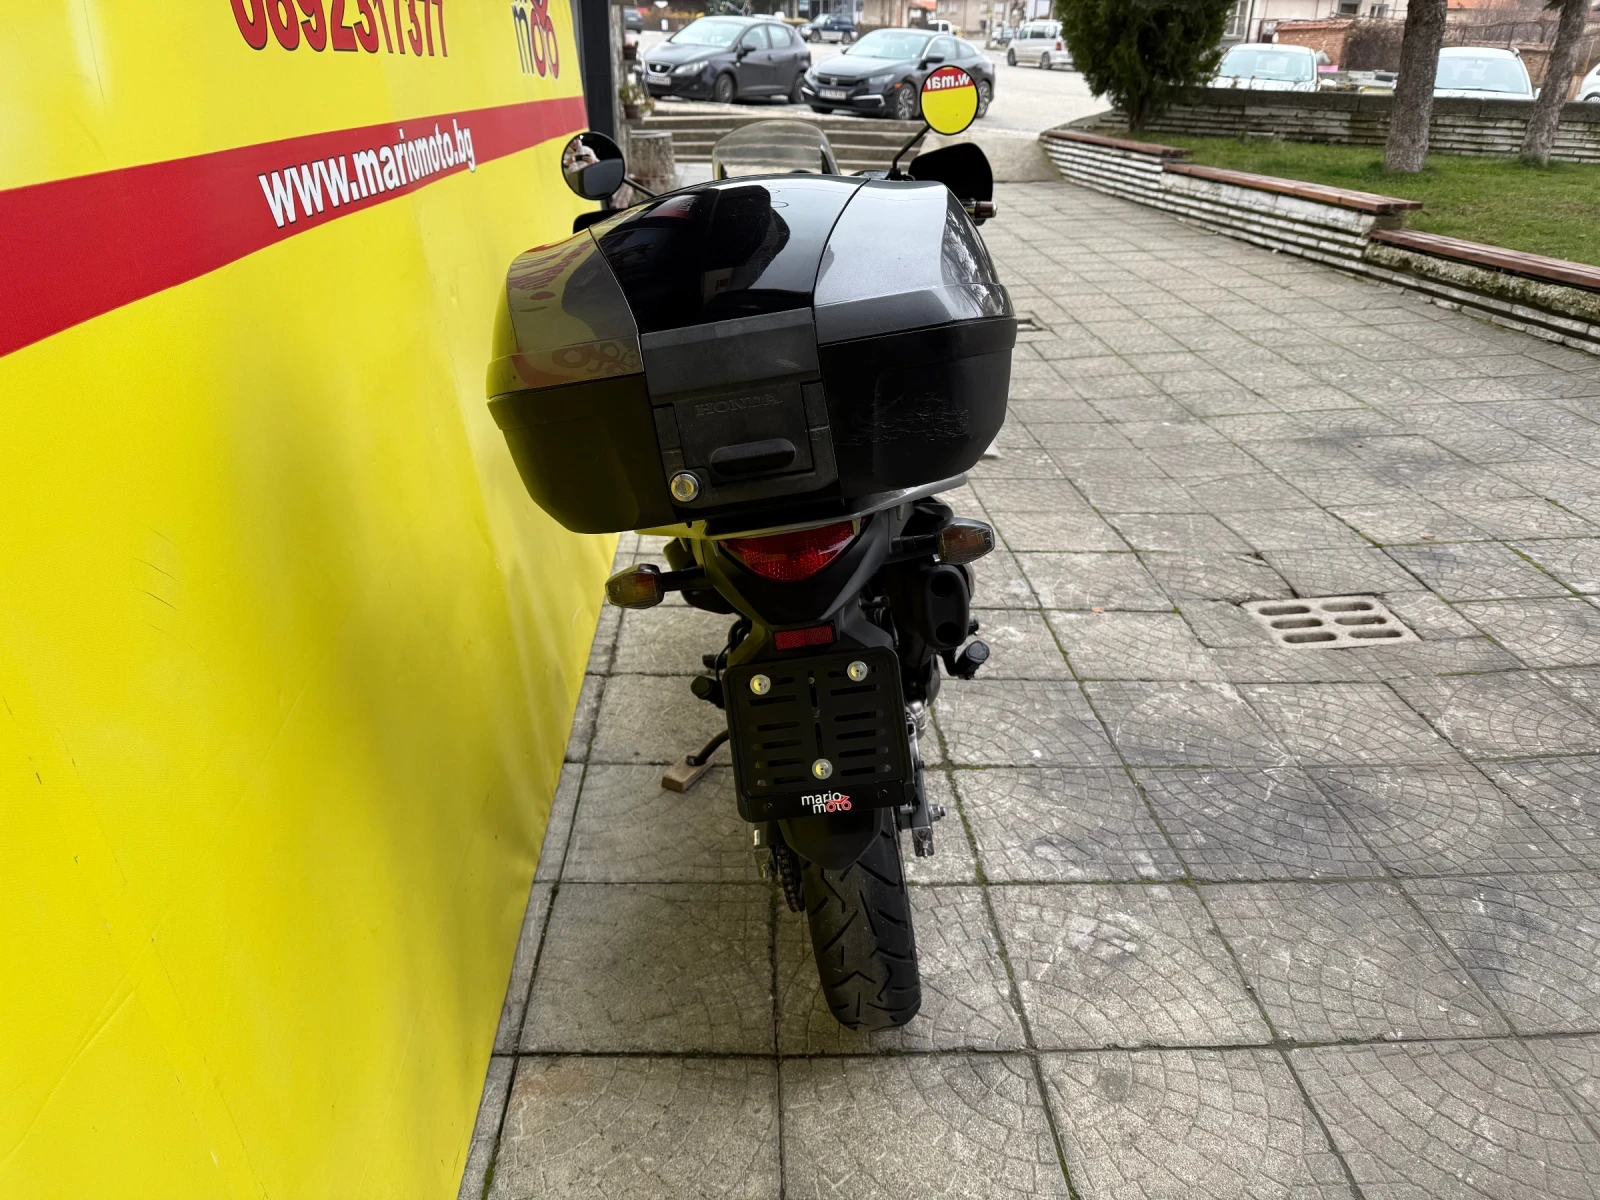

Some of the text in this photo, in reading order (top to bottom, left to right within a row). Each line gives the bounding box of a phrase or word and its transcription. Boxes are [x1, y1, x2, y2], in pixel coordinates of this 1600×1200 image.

[258, 118, 477, 228] www.mariomoto.bg
[694, 393, 784, 417] HONDA
[801, 790, 842, 806] mario
[812, 800, 852, 814] moto
